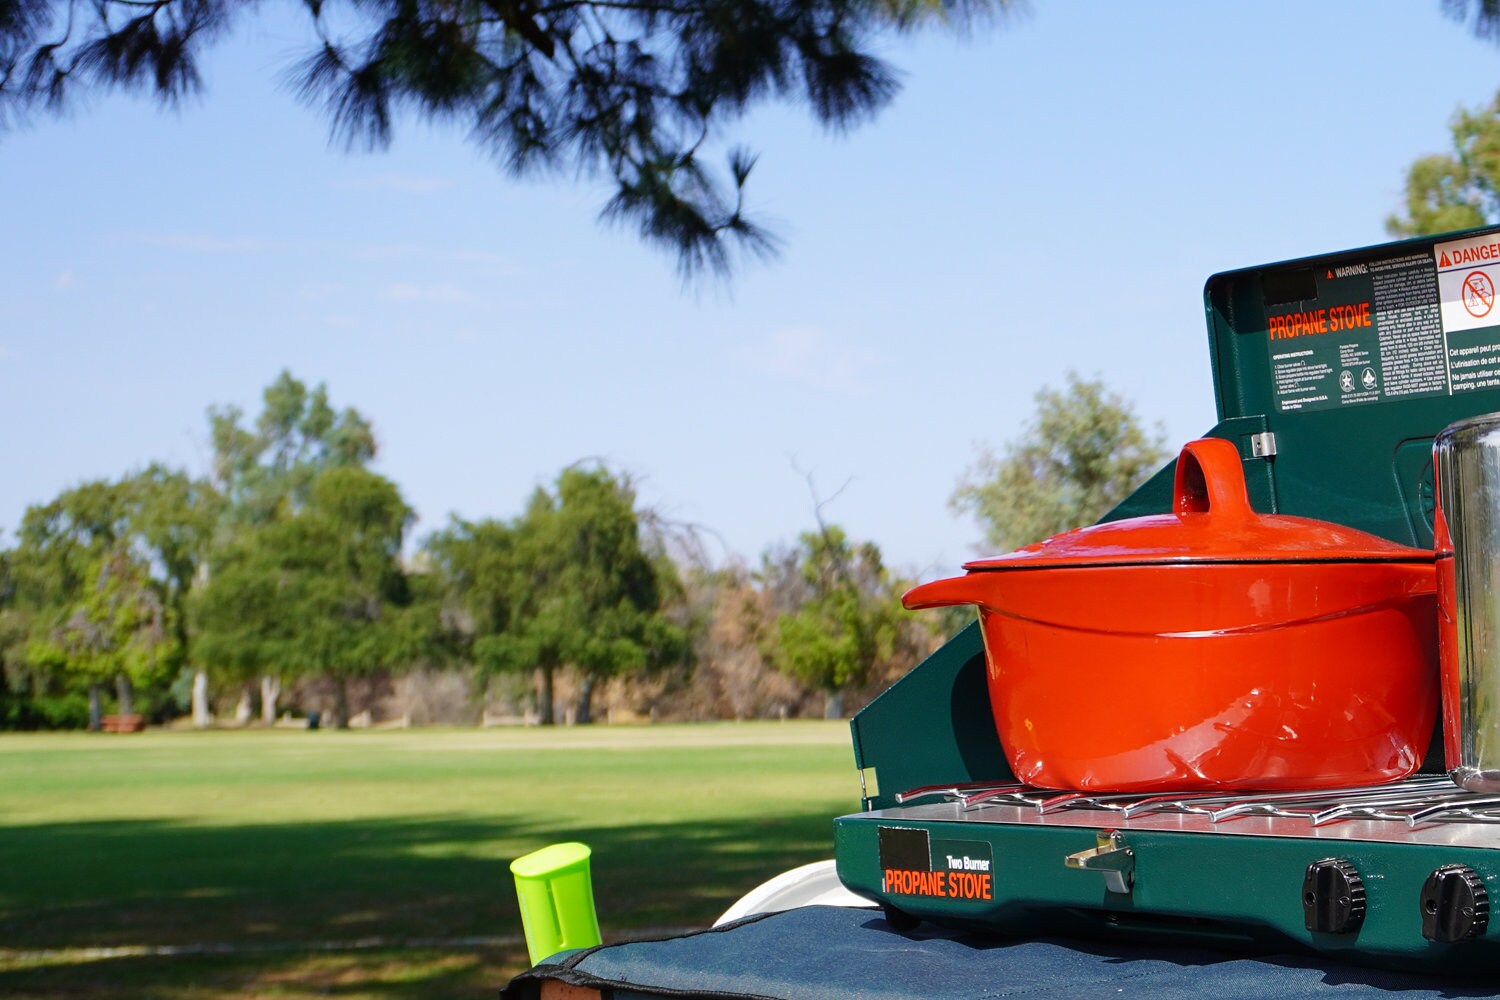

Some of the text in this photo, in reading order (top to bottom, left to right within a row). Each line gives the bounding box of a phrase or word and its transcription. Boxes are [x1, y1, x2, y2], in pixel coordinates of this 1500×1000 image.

[1334, 264, 1369, 278] WARNING:
[1268, 302, 1372, 340] PROPANE STOVE
[1449, 348, 1459, 357] Cet
[1459, 345, 1479, 357] appareil
[1479, 343, 1492, 354] peut
[1480, 357, 1487, 365] de
[1487, 356, 1496, 364] cet
[1451, 373, 1459, 381] Ne
[946, 856, 990, 871] Two Burner
[885, 869, 992, 900] PROPANE STOVE
